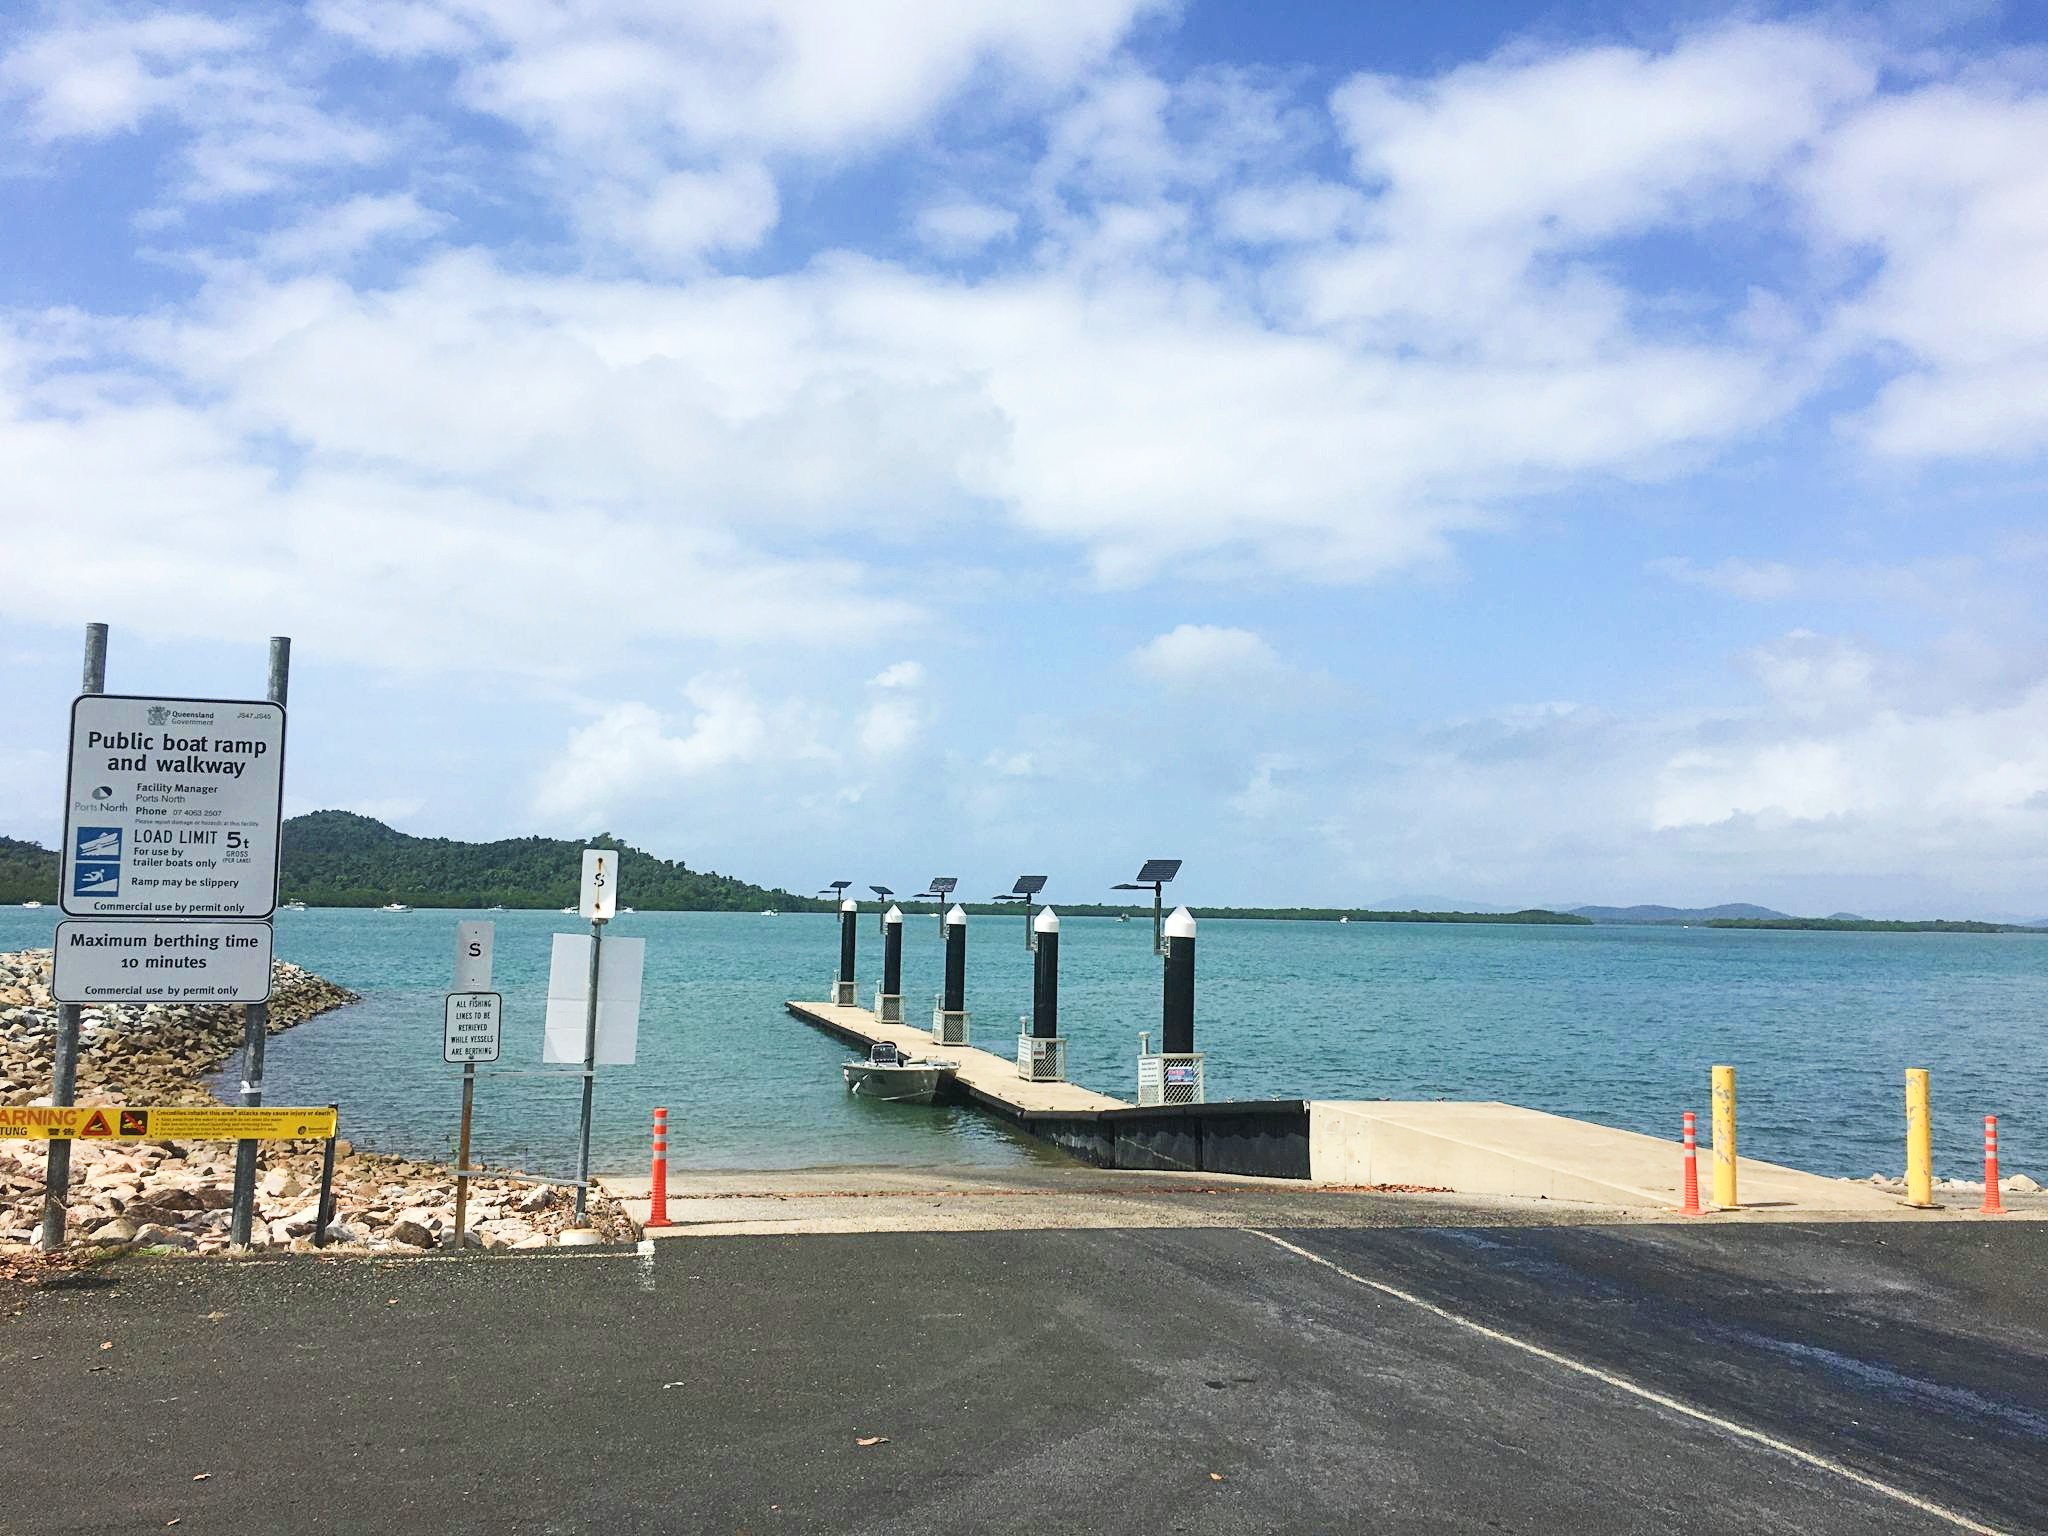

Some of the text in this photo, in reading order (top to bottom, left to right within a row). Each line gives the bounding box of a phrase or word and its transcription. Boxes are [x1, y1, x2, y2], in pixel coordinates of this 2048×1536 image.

[171, 710, 215, 719] Queensland
[88, 731, 267, 758] Public boat ramp
[107, 754, 246, 779] and walkway
[136, 782, 219, 795] Facility Manager
[135, 794, 186, 804] Ports North
[74, 802, 128, 813] Ports North
[135, 806, 167, 816] Phone
[134, 829, 218, 845] LOAD LIMIT
[226, 831, 250, 849] 5t
[134, 847, 149, 856] For
[171, 847, 184, 858] by
[133, 858, 217, 869] trailer boats only
[131, 877, 239, 889] Ramp may be slippery
[594, 873, 605, 887] S
[94, 902, 152, 912] Commercial
[175, 903, 187, 913] by
[189, 903, 221, 914] permit
[223, 904, 245, 914] only
[70, 933, 259, 951] Maximum berthing time
[468, 942, 482, 957] S
[121, 956, 207, 969] 10 minutes
[85, 986, 142, 996] Commercial
[167, 986, 180, 997] by
[183, 986, 214, 997] permit
[217, 986, 238, 997] only
[456, 1000, 492, 1008] ALL FISHING
[458, 1024, 488, 1032] RETRIEVED
[471, 1035, 494, 1043] VESSELS
[451, 1047, 492, 1056] ARE BERTHING
